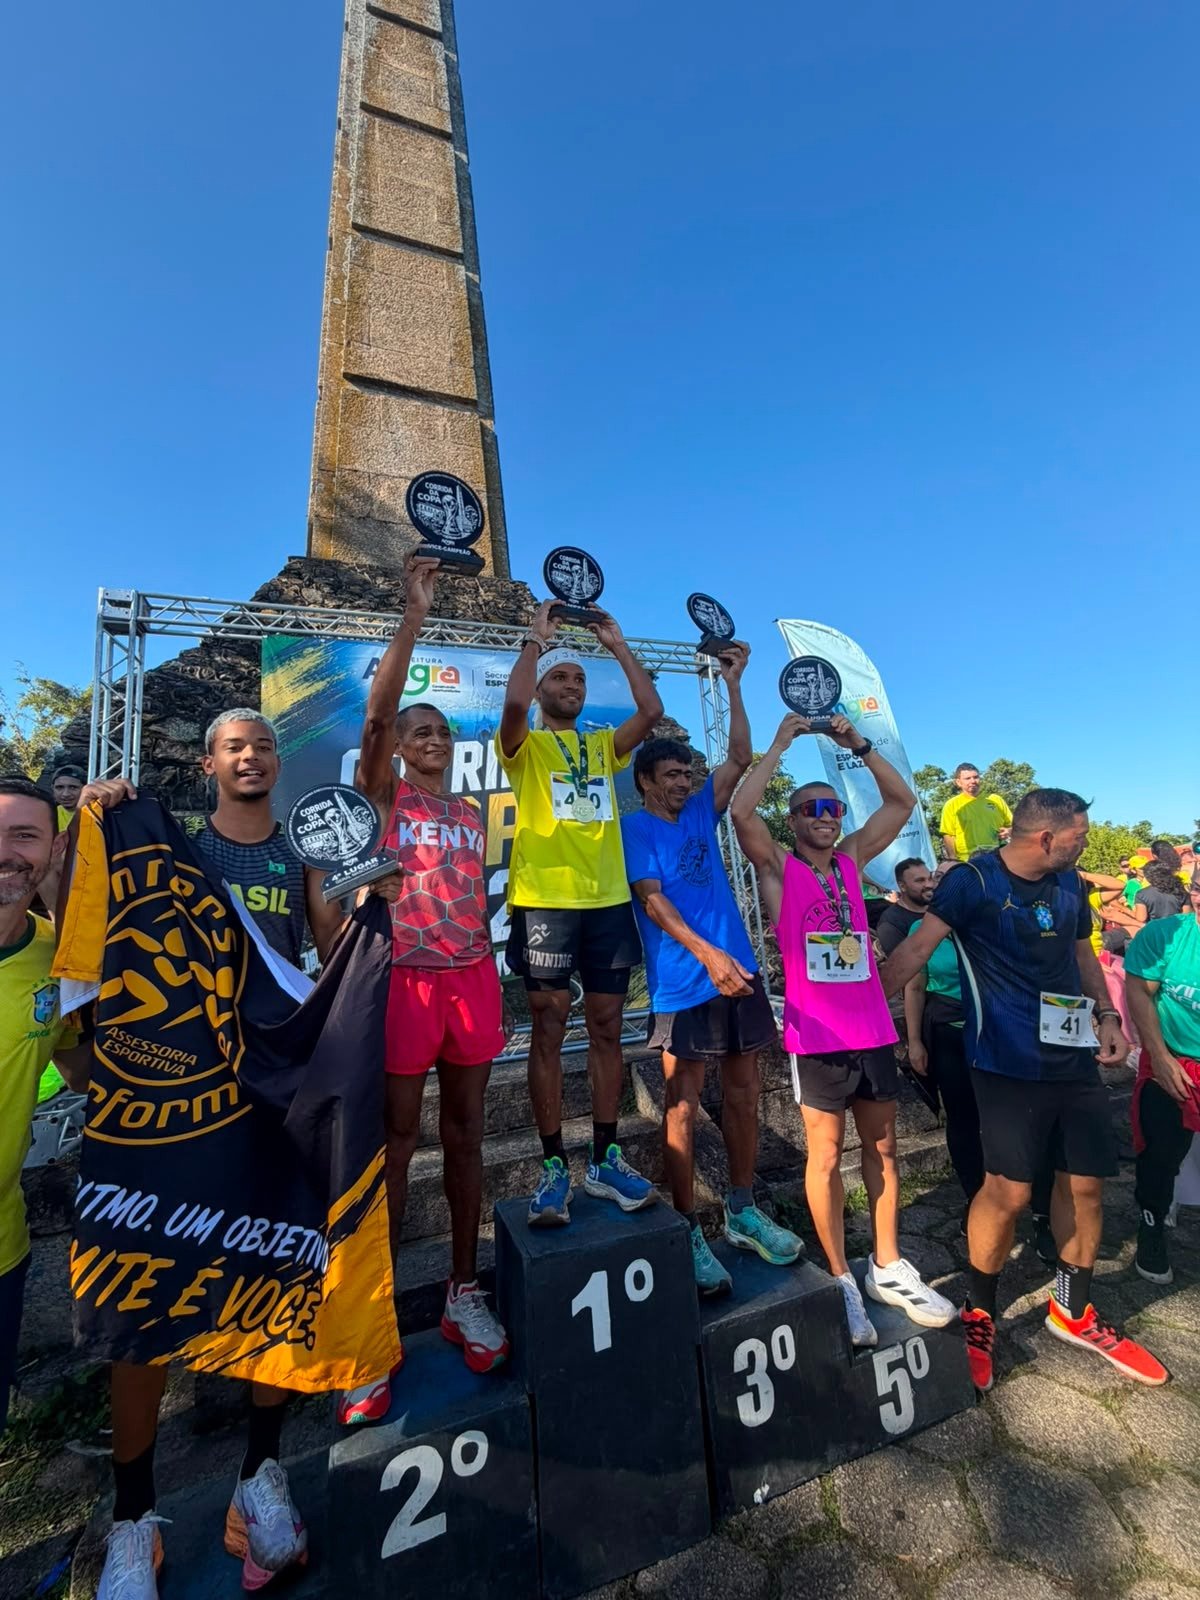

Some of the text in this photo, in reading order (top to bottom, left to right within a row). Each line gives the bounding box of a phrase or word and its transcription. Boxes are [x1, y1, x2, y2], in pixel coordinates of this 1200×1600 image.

[417, 493, 442, 504] COPA
[424, 482, 454, 495] CORRIDA
[300, 799, 334, 817] CORRIDA
[307, 812, 321, 822] DA
[297, 818, 326, 834] COPA
[343, 856, 379, 876] LUGAR
[523, 948, 573, 968] RUNNING
[1061, 1016, 1081, 1036] 41
[105, 1026, 198, 1066] ASSESSORIA
[102, 1039, 186, 1077] ESPORTIVA
[75, 1174, 159, 1231] ITMO.
[164, 1202, 225, 1246] UM
[168, 1256, 228, 1318] É
